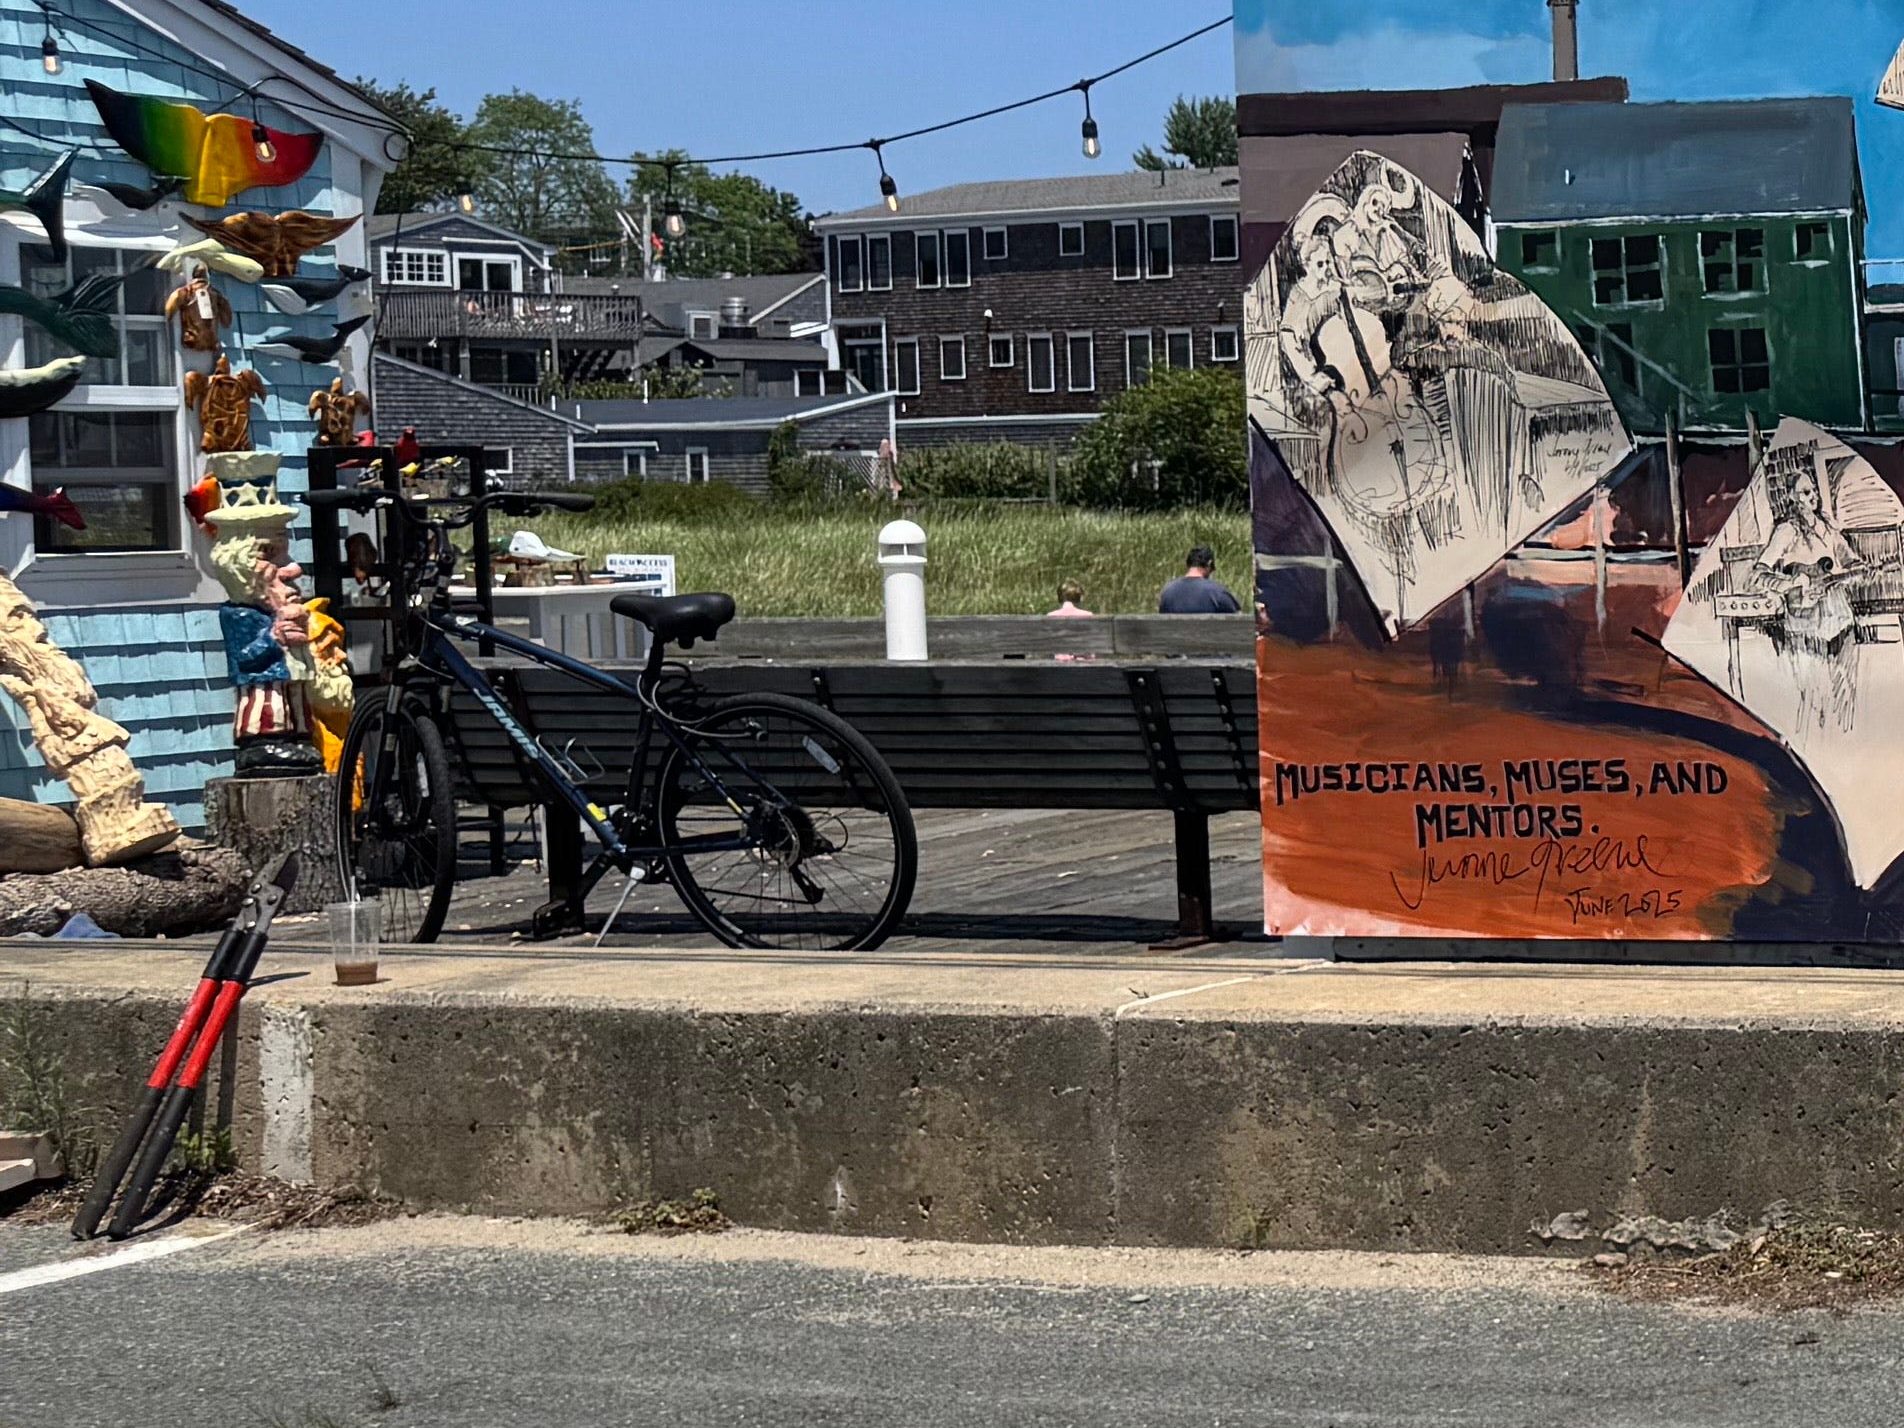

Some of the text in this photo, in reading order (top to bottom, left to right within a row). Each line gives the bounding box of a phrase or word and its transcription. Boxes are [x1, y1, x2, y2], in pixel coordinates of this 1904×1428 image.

[1275, 758, 1729, 806] MUSICIANS, MUSES, AND
[1414, 803, 1600, 849] MENTORS.
[1618, 889, 1683, 918] 2025
